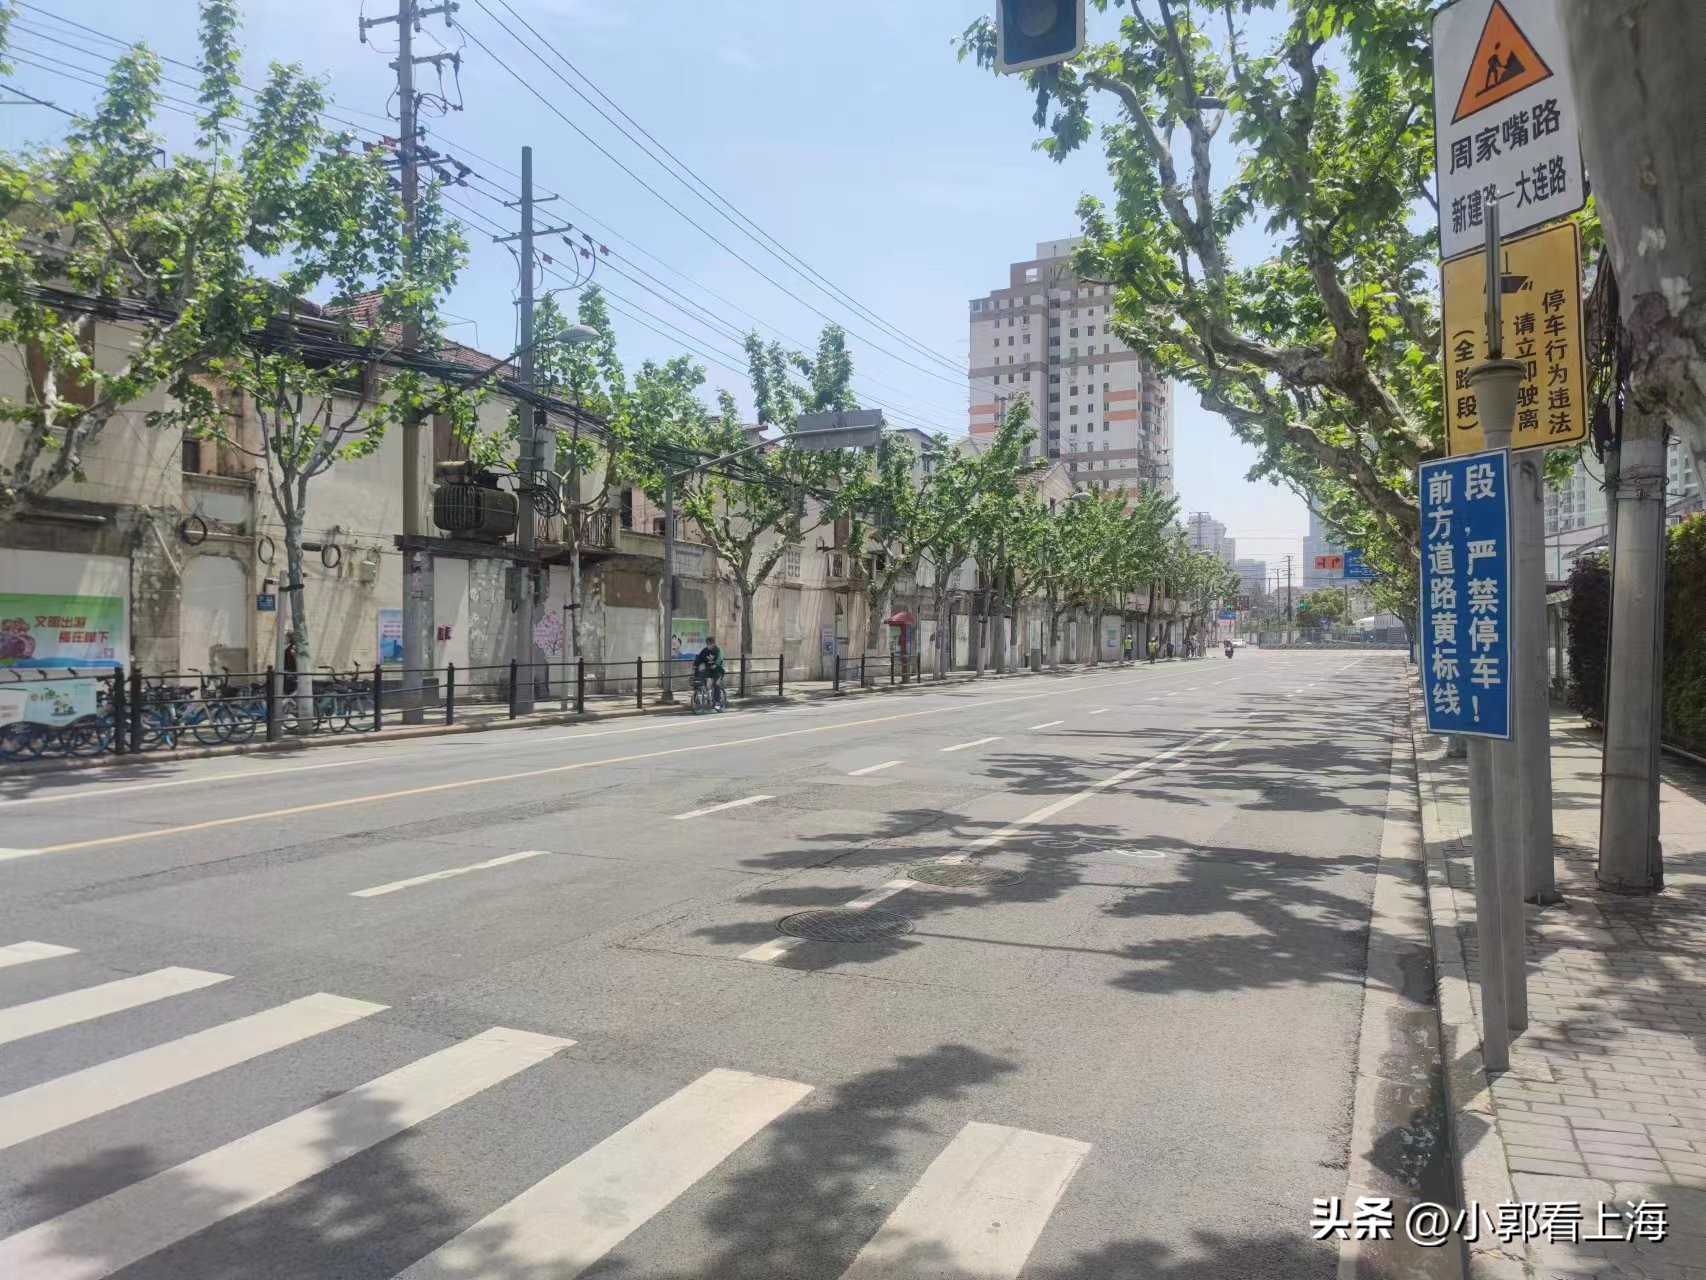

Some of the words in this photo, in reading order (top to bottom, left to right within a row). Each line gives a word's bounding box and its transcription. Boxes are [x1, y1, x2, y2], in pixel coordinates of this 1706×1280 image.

[1450, 98, 1561, 175] 周家嘴路
[1542, 289, 1572, 435] 停车行为违法
[1427, 471, 1461, 715] 前方道路黄标线
